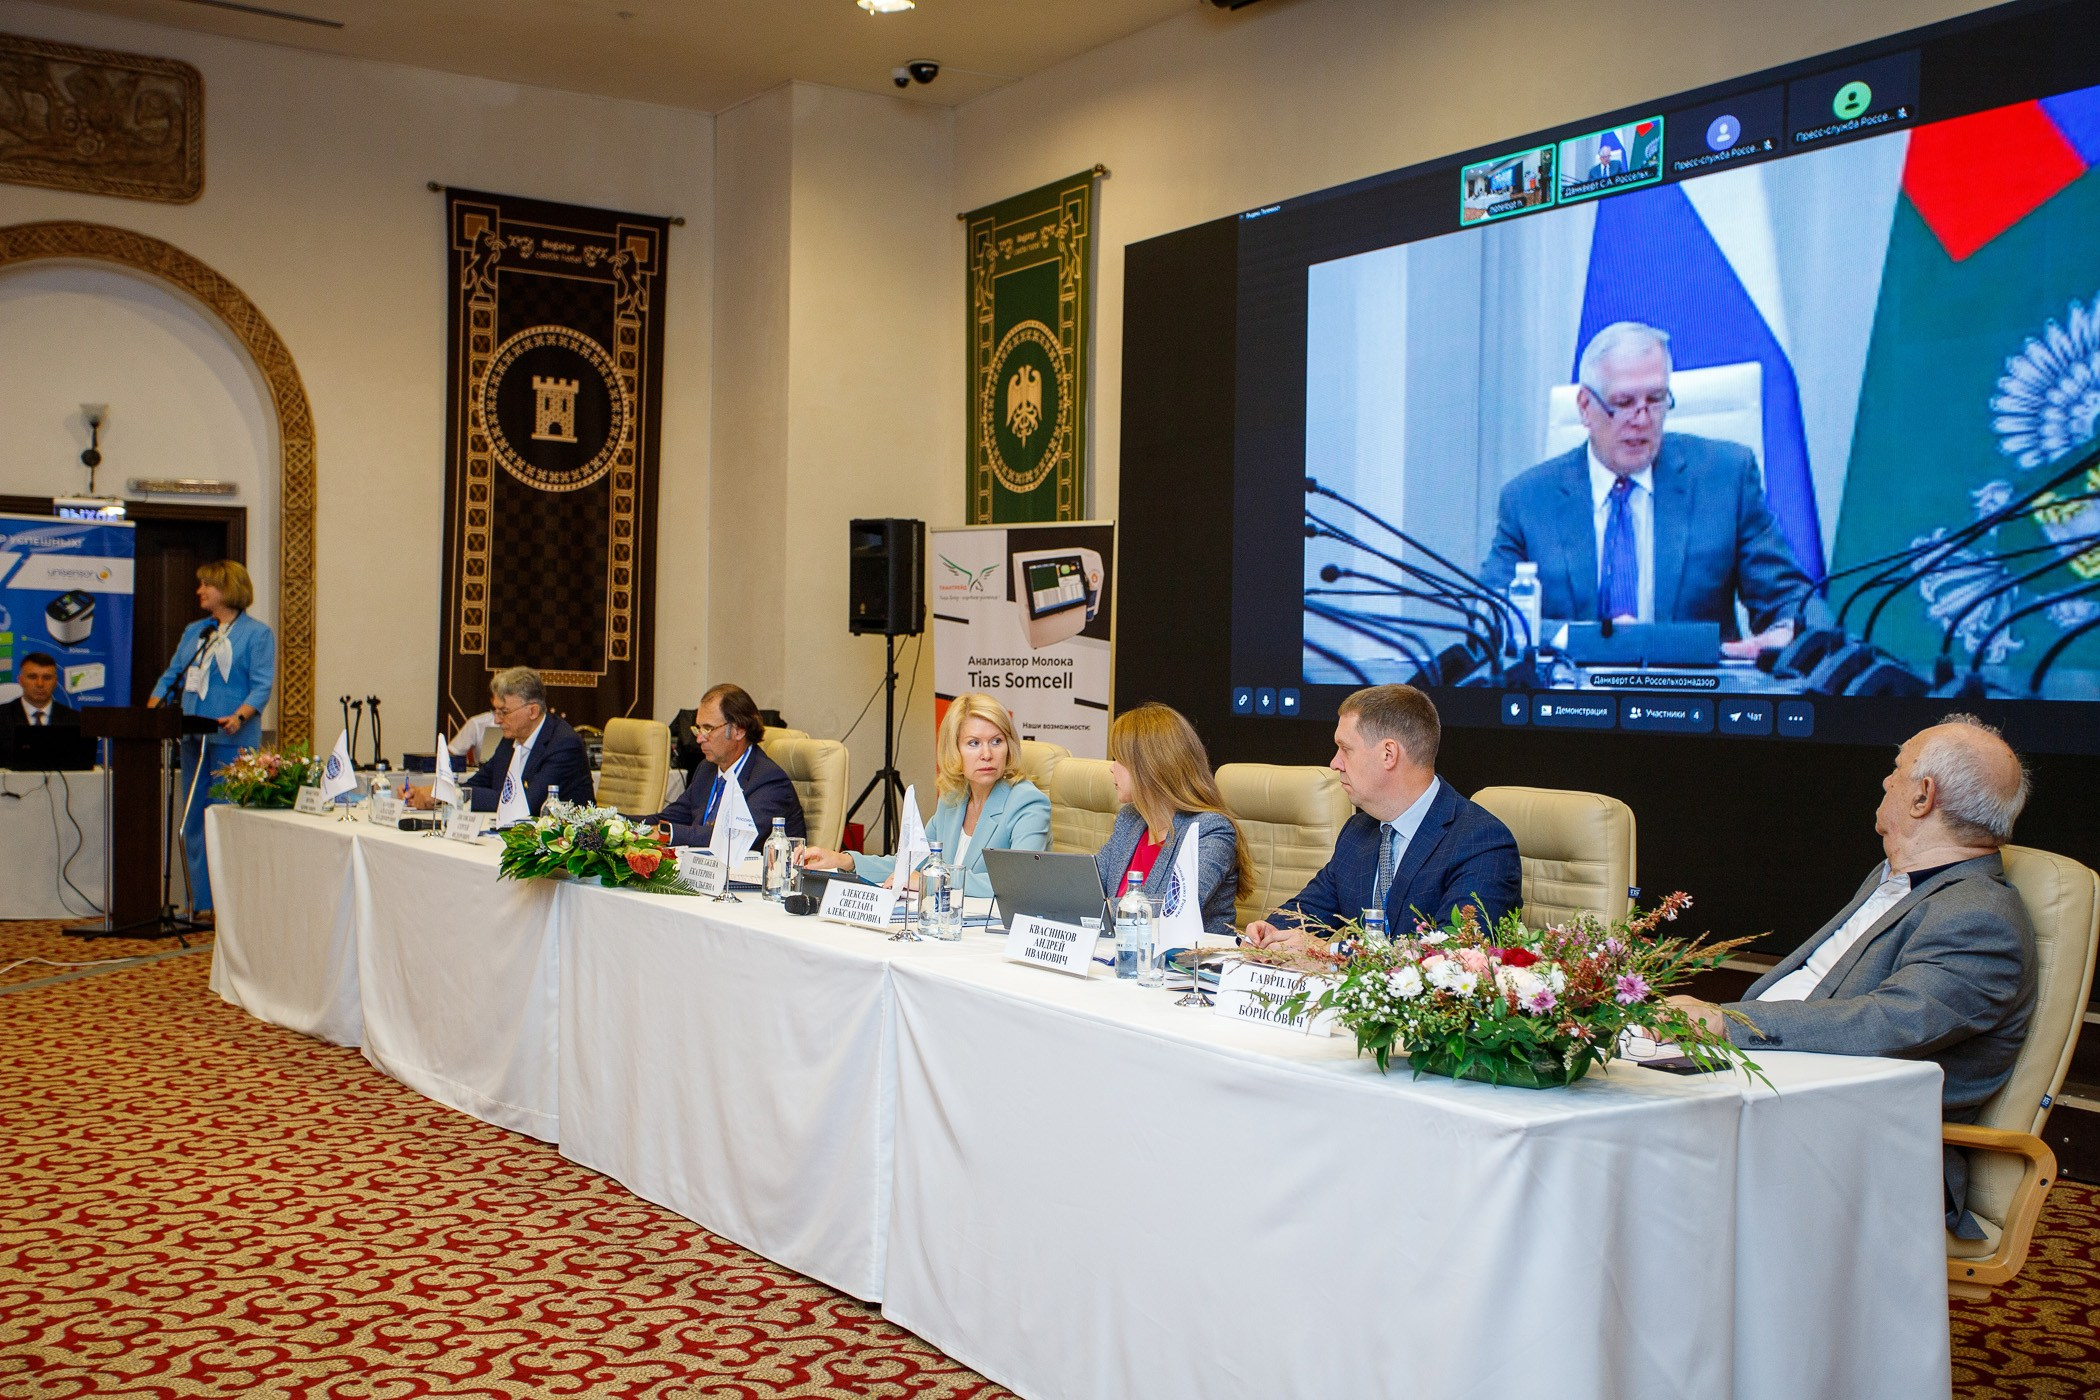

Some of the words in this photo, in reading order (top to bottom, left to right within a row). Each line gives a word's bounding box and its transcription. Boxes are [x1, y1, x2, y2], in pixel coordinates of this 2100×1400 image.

[968, 655, 1029, 668] Анализатор
[1031, 656, 1074, 667] Молока
[968, 670, 1000, 688] Tias
[1005, 671, 1073, 689] Somcell
[1593, 676, 1629, 686] Данкверт
[1629, 677, 1644, 686] С.А.
[1644, 677, 1716, 688] Россельхознадзор
[1555, 705, 1608, 717] Демонстрация
[1645, 708, 1686, 720] Участники
[1746, 711, 1763, 722] Чат
[1022, 722, 1042, 730] Наши
[1043, 723, 1091, 731] возможности:
[841, 888, 879, 902] АЛЕКСЕЕВА
[839, 898, 874, 912] СВЕТЛАНА
[826, 907, 881, 924] АЛЕКСАНДРОВНА
[1028, 924, 1077, 943] КВАСНИКОВ
[1033, 938, 1066, 953] АНДРЕЙ
[1024, 947, 1068, 966] ИВАНОВИЧ
[1250, 971, 1307, 992] ГАВРИЛОВ
